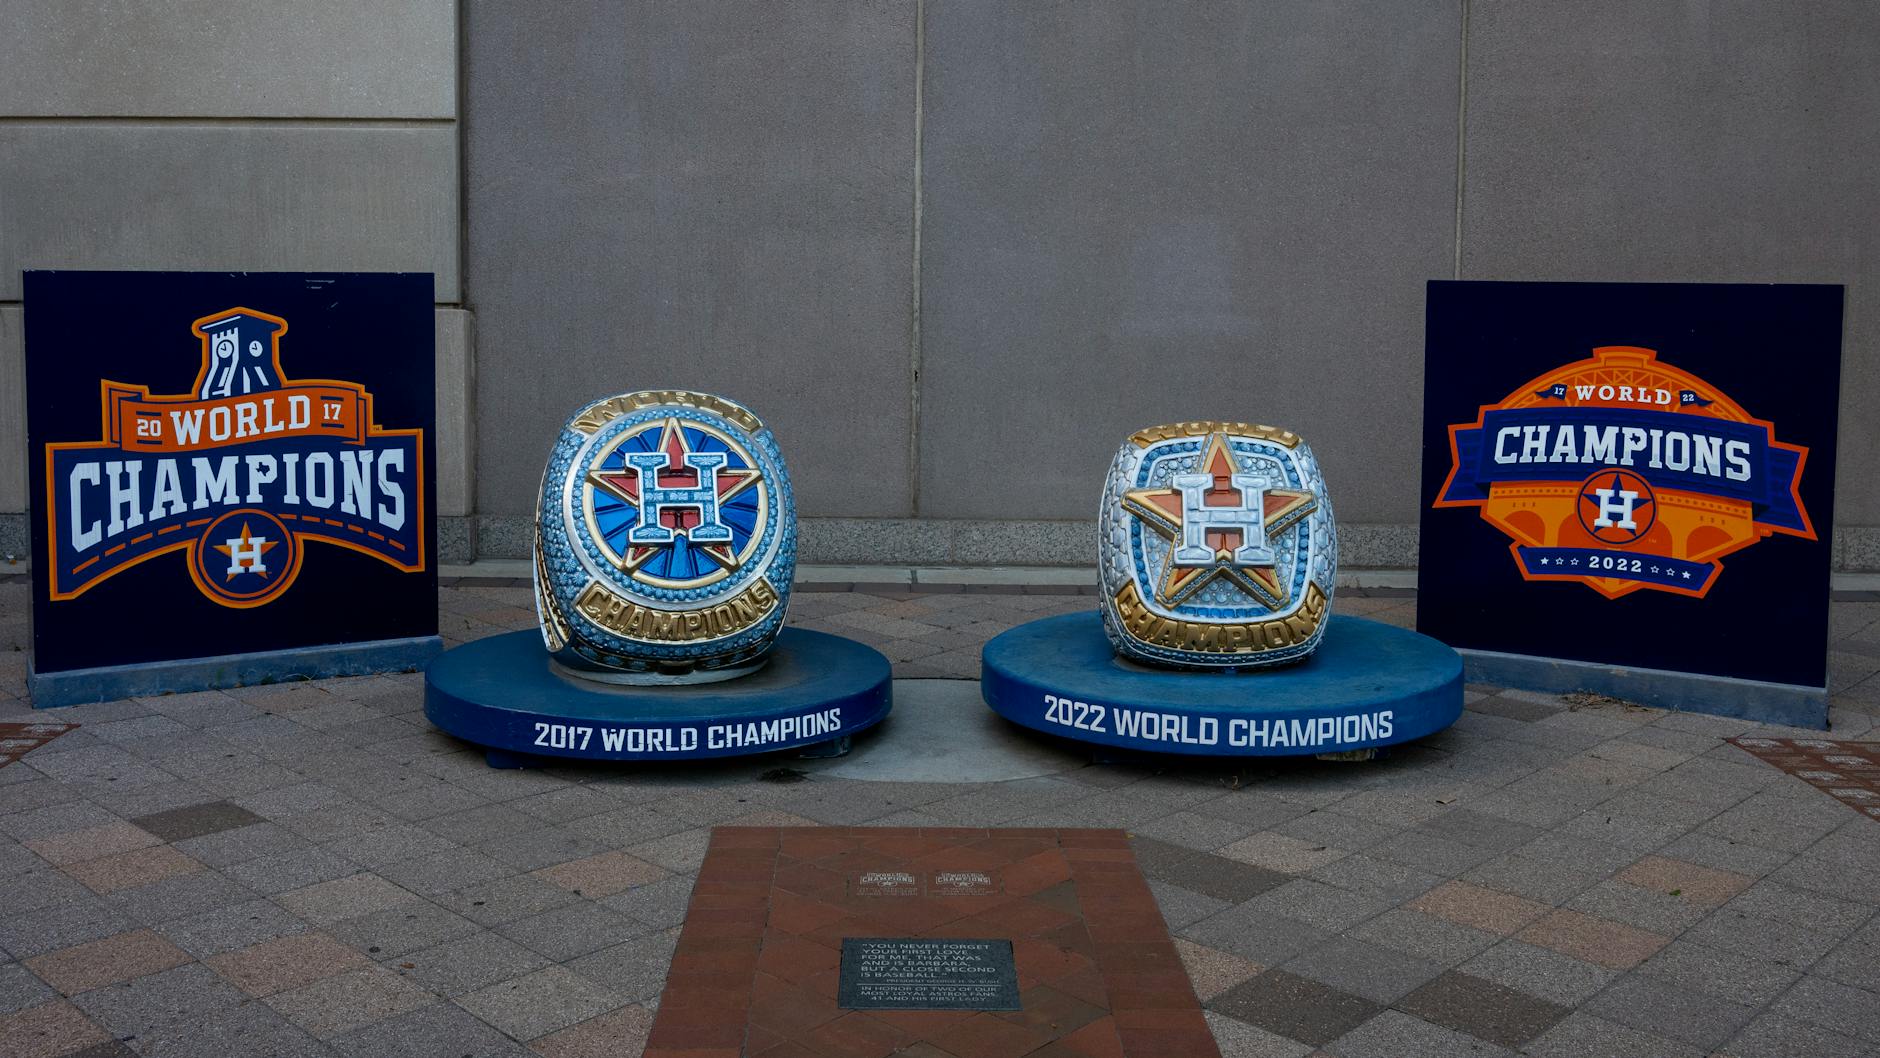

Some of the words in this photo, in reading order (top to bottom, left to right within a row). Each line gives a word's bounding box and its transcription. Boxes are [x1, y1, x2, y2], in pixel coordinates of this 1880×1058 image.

[137, 419, 161, 437] 20
[170, 395, 311, 445] WORLD
[323, 403, 341, 421] 17
[1554, 386, 1565, 396] 17
[1575, 385, 1672, 405] WORLD
[1682, 393, 1694, 402] 22
[1495, 425, 1751, 482] CHAMPIONS
[69, 449, 405, 553] CHAMPIONS
[625, 452, 733, 543] H
[1172, 473, 1275, 568] H
[1594, 487, 1638, 530] H
[226, 536, 267, 575] H
[1588, 556, 1643, 573] 2022
[584, 582, 777, 641] CHAMPIONS
[1116, 586, 1326, 653] CHAMPIONS
[534, 722, 593, 751] 2017
[600, 727, 698, 752] WORLD
[707, 708, 842, 750] CHAMPIONS
[1044, 694, 1106, 733] 2022
[1113, 708, 1219, 746] WORLD
[1229, 710, 1393, 748] CHAMPIONS
